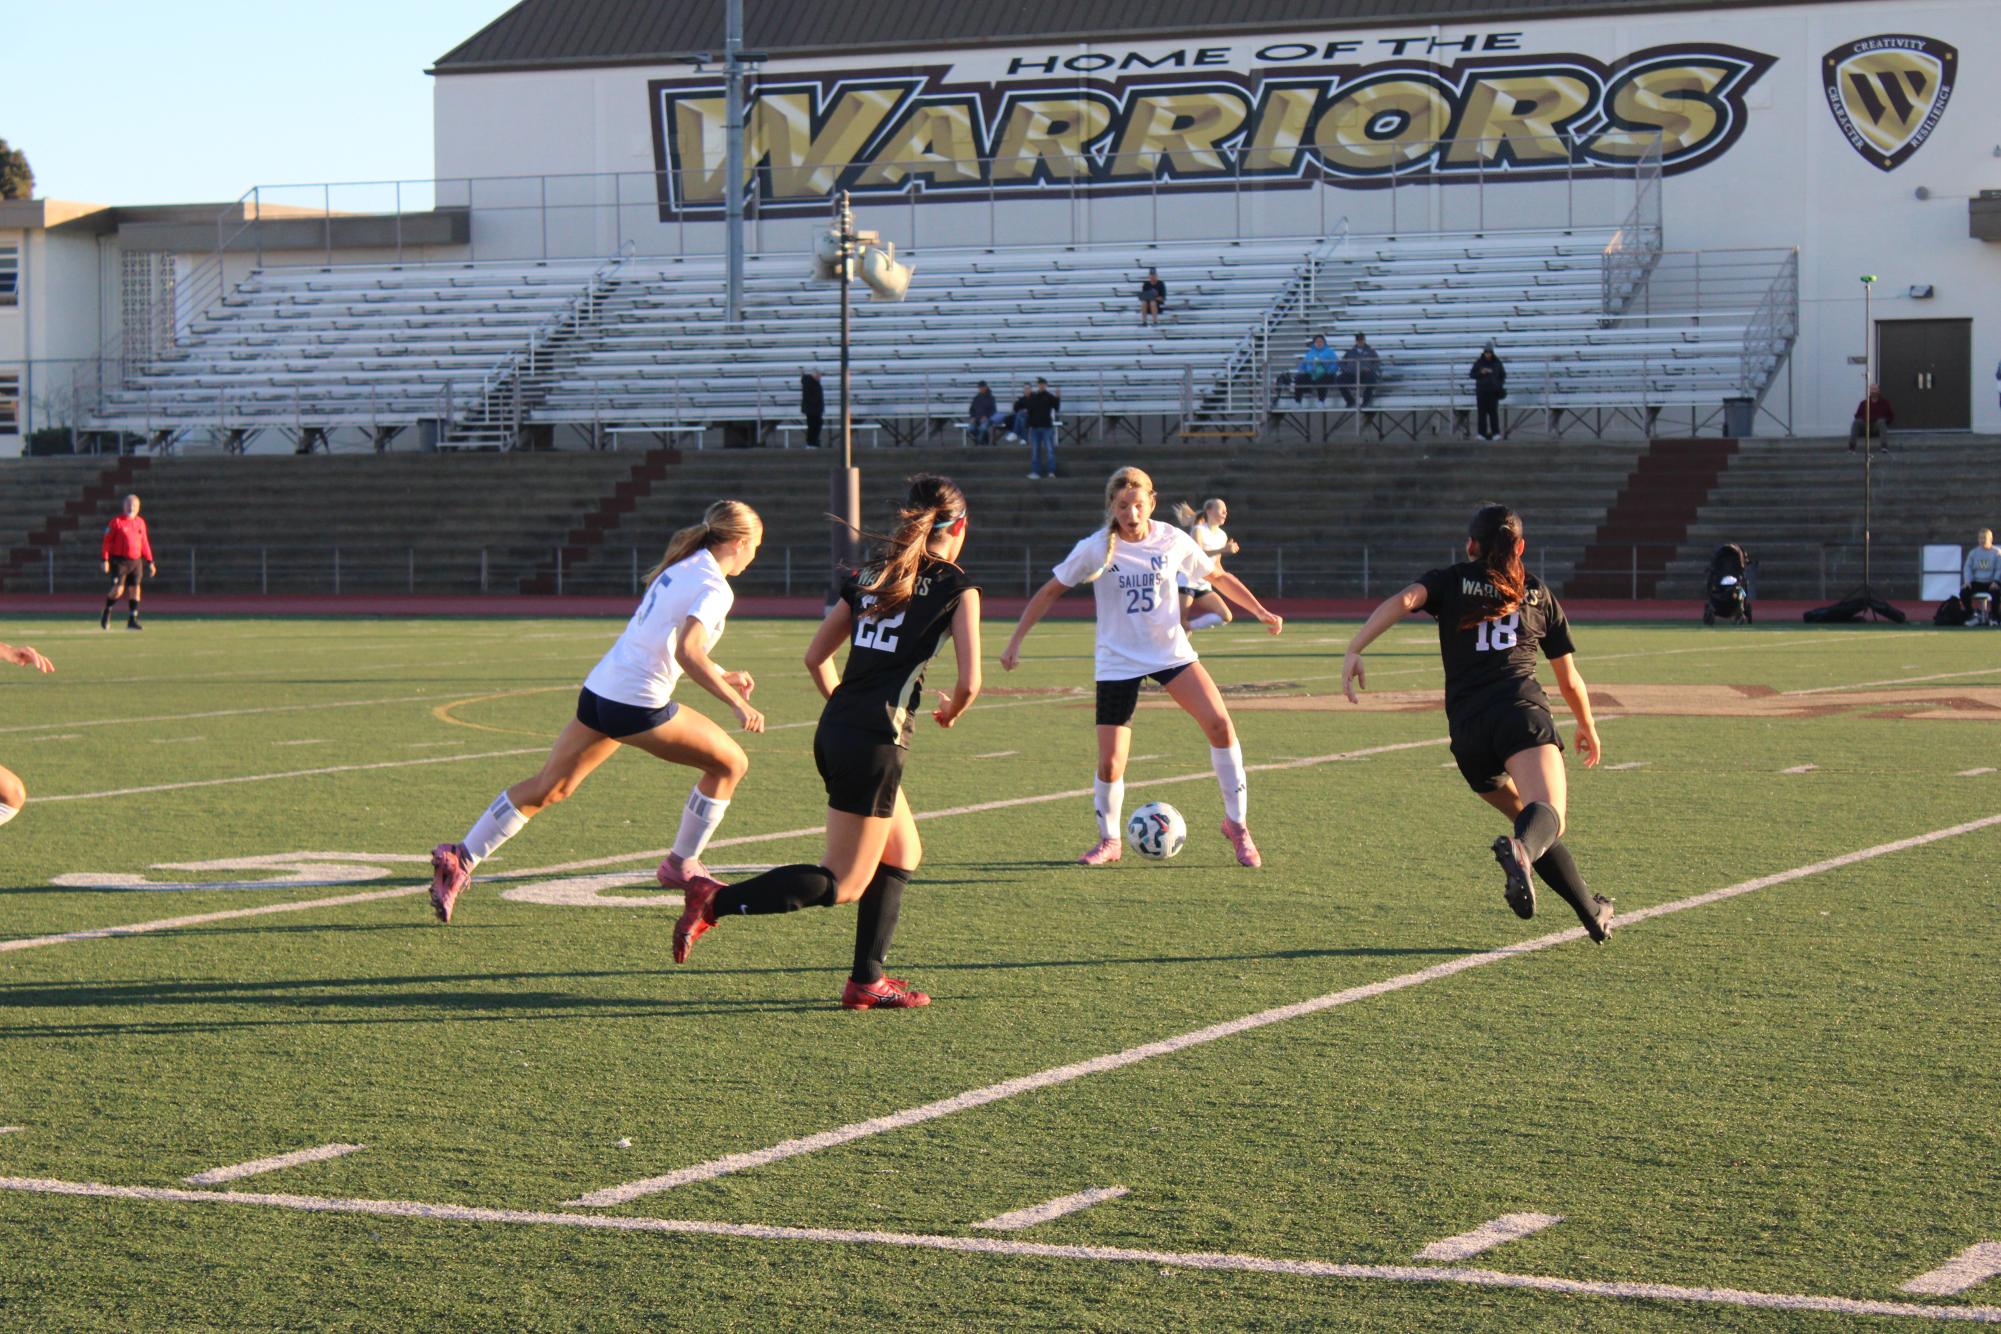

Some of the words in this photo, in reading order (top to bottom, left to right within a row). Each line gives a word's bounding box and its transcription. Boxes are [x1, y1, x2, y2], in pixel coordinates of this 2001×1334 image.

[1007, 47, 1231, 75] HOME
[1255, 40, 1363, 60] OF
[1378, 32, 1522, 56] THE
[1853, 38, 1926, 53] CREATIVITY
[665, 52, 1755, 210] WARRIORS
[1828, 86, 1865, 150] CHARACTER
[1910, 84, 1951, 148] RESILIENCE
[1119, 572, 1162, 588] SAILORS
[1127, 588, 1154, 614] 25
[1475, 610, 1520, 652] 18
